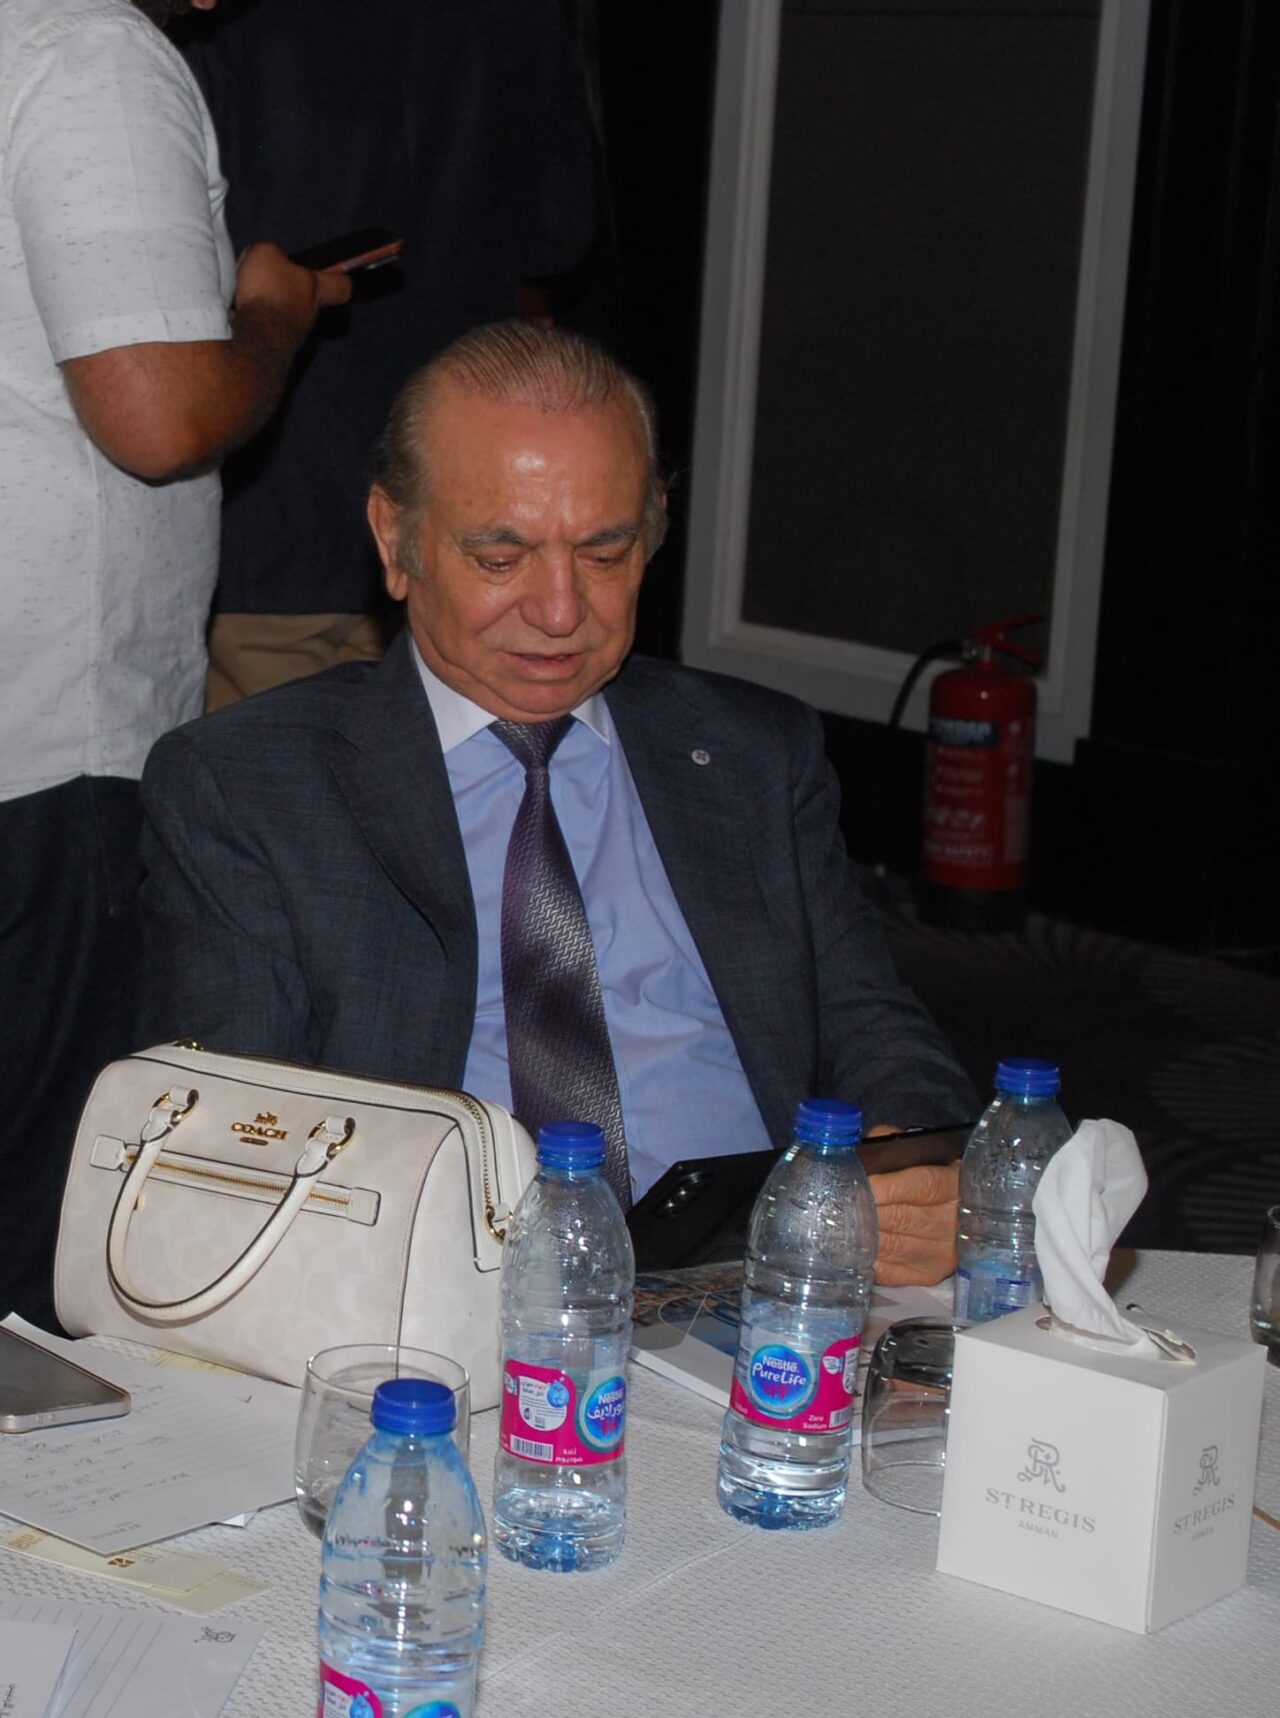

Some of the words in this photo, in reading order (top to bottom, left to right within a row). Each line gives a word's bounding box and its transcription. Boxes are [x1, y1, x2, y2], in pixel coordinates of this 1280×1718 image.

[231, 1122, 287, 1140] COACH
[1019, 1497, 1096, 1533] REGIS
[1192, 1493, 1236, 1526] REGIS
[1018, 1520, 1059, 1539] AMMAN
